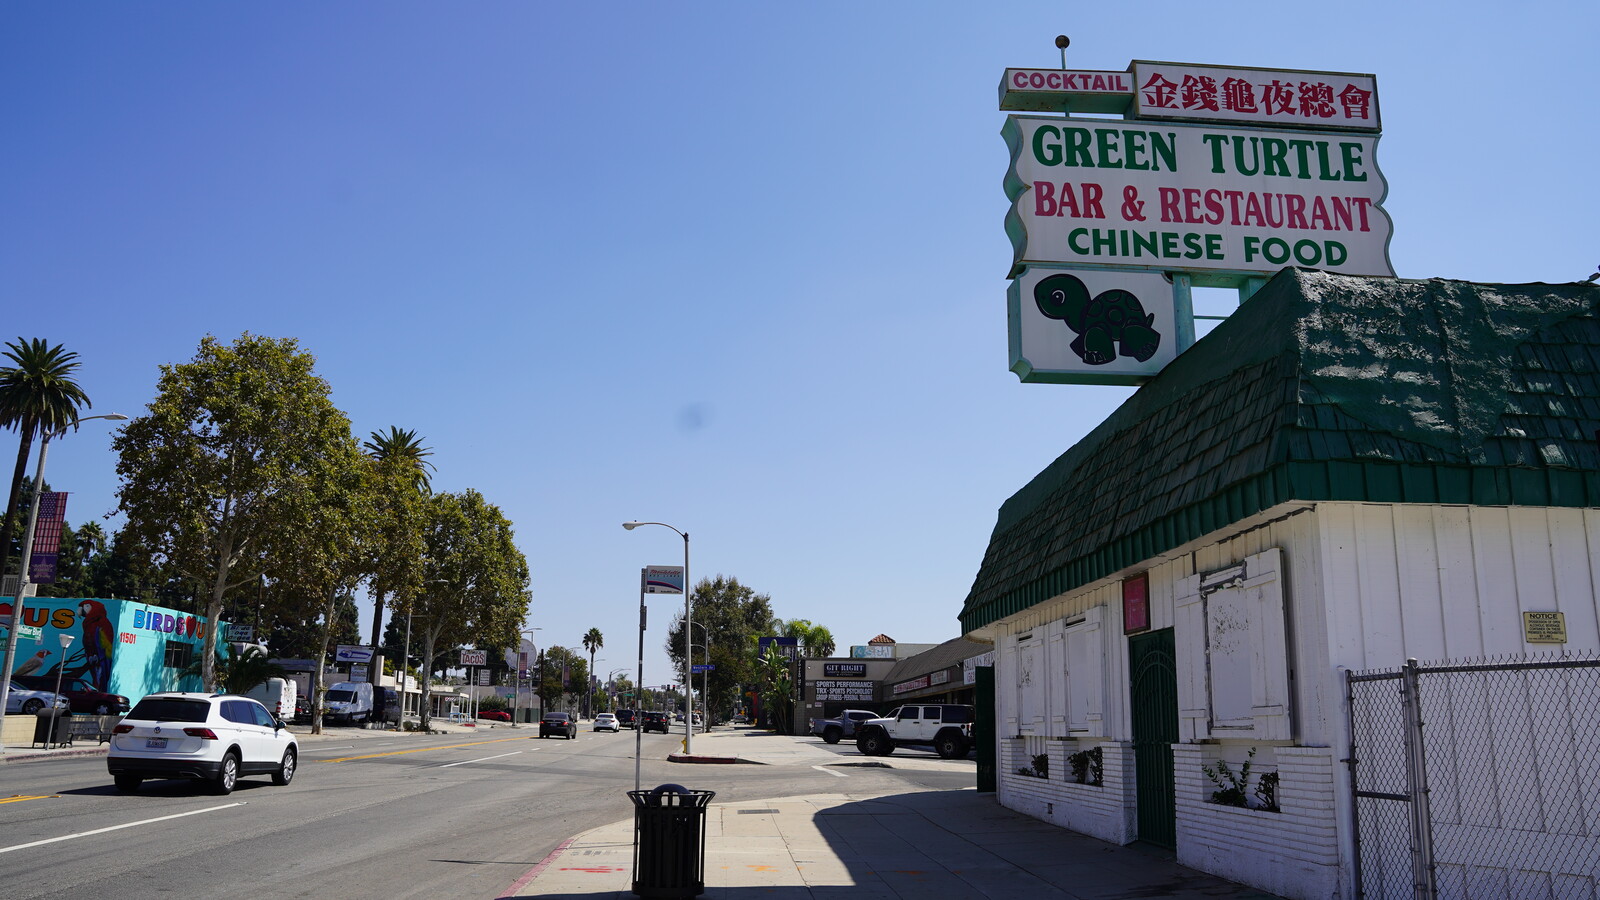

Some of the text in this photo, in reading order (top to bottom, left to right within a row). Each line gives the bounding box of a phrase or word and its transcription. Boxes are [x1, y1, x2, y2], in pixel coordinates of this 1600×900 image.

[1013, 71, 1129, 92] COCKTAIL
[1141, 72, 1373, 120] 金錢龜夜總會
[1032, 124, 1368, 182] GREEN TURTLE
[1034, 180, 1373, 232] BAR & RESTAURANT
[1067, 227, 1348, 266] CHINESE FOOD
[23, 607, 76, 629] US
[133, 609, 184, 635] BIRDS
[119, 631, 136, 644] 11501
[462, 653, 485, 664] TACOS
